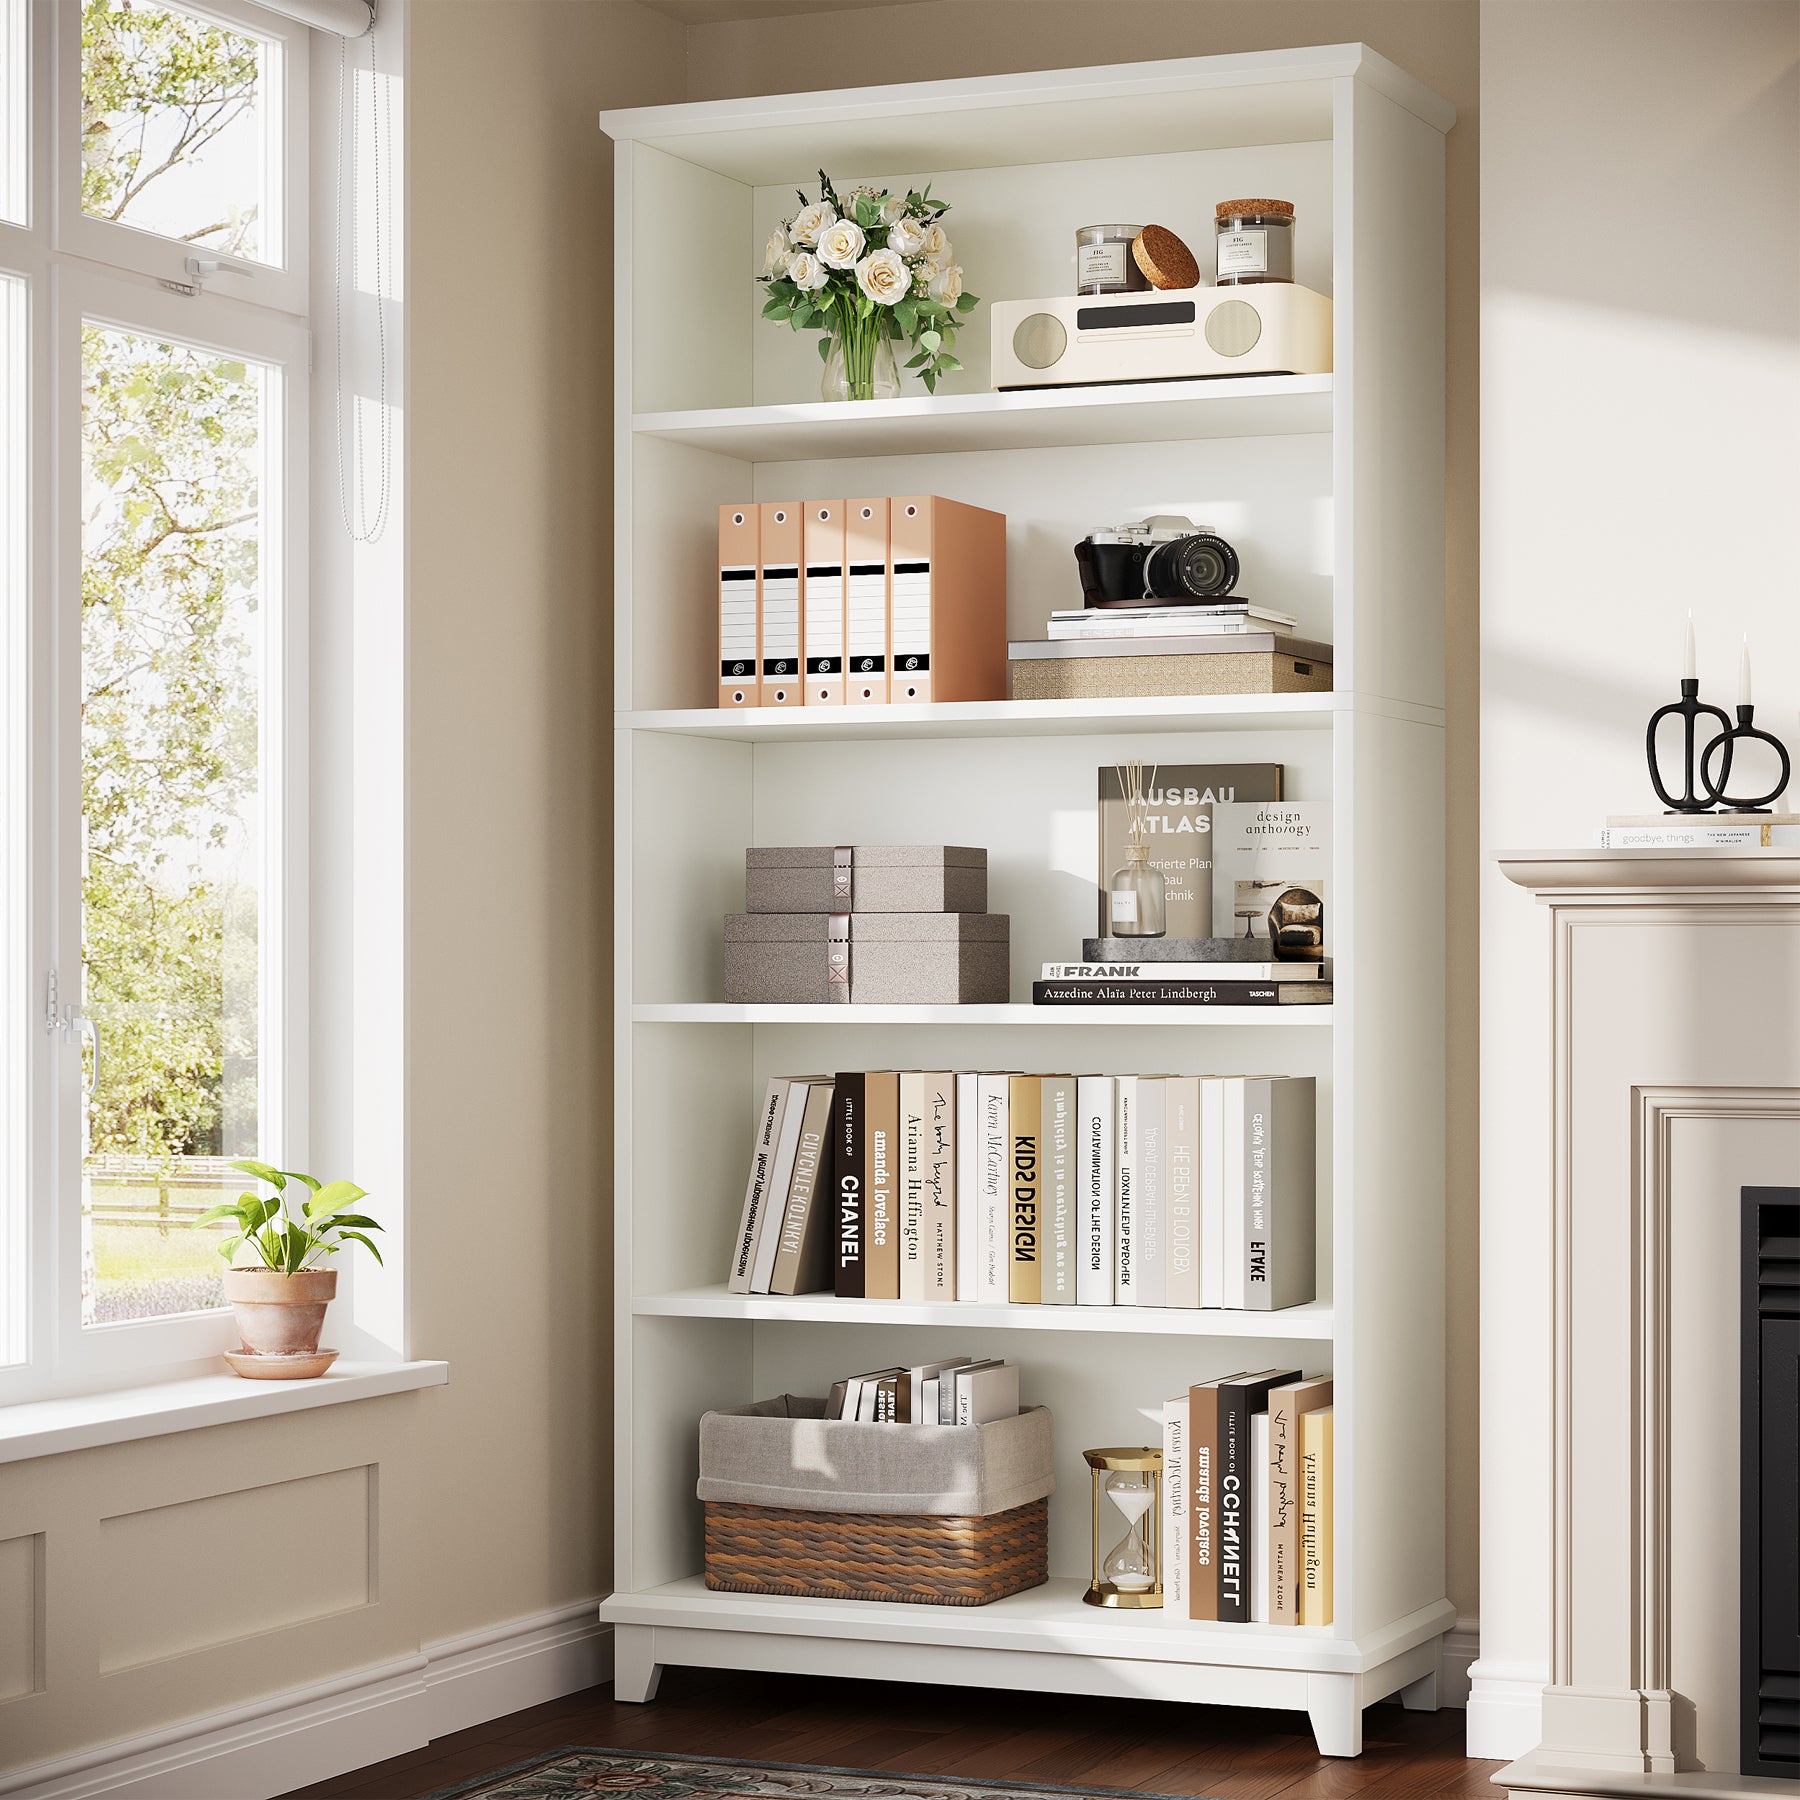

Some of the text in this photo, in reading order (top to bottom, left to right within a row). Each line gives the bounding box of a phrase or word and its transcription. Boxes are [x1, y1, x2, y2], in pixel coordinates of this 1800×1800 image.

[1128, 786, 1236, 807] AUSBAU
[1128, 814, 1212, 835] ATLAS
[1256, 810, 1301, 824] design
[1245, 823, 1312, 836] anthology
[1622, 833, 1695, 845] goodbye, things
[1063, 965, 1141, 978] FRANK
[1043, 986, 1217, 1002] Azzedine Alaïa Peter Lindbergh
[982, 1094, 1003, 1197] Karen McCartney
[840, 1097, 860, 1268] LITTLE BOOK OF CHANEL
[873, 1130, 891, 1246] amanda lovelace
[902, 1113, 923, 1261] Arianna Huffington
[924, 1092, 951, 1288] The body beyond MATTHEW STONE
